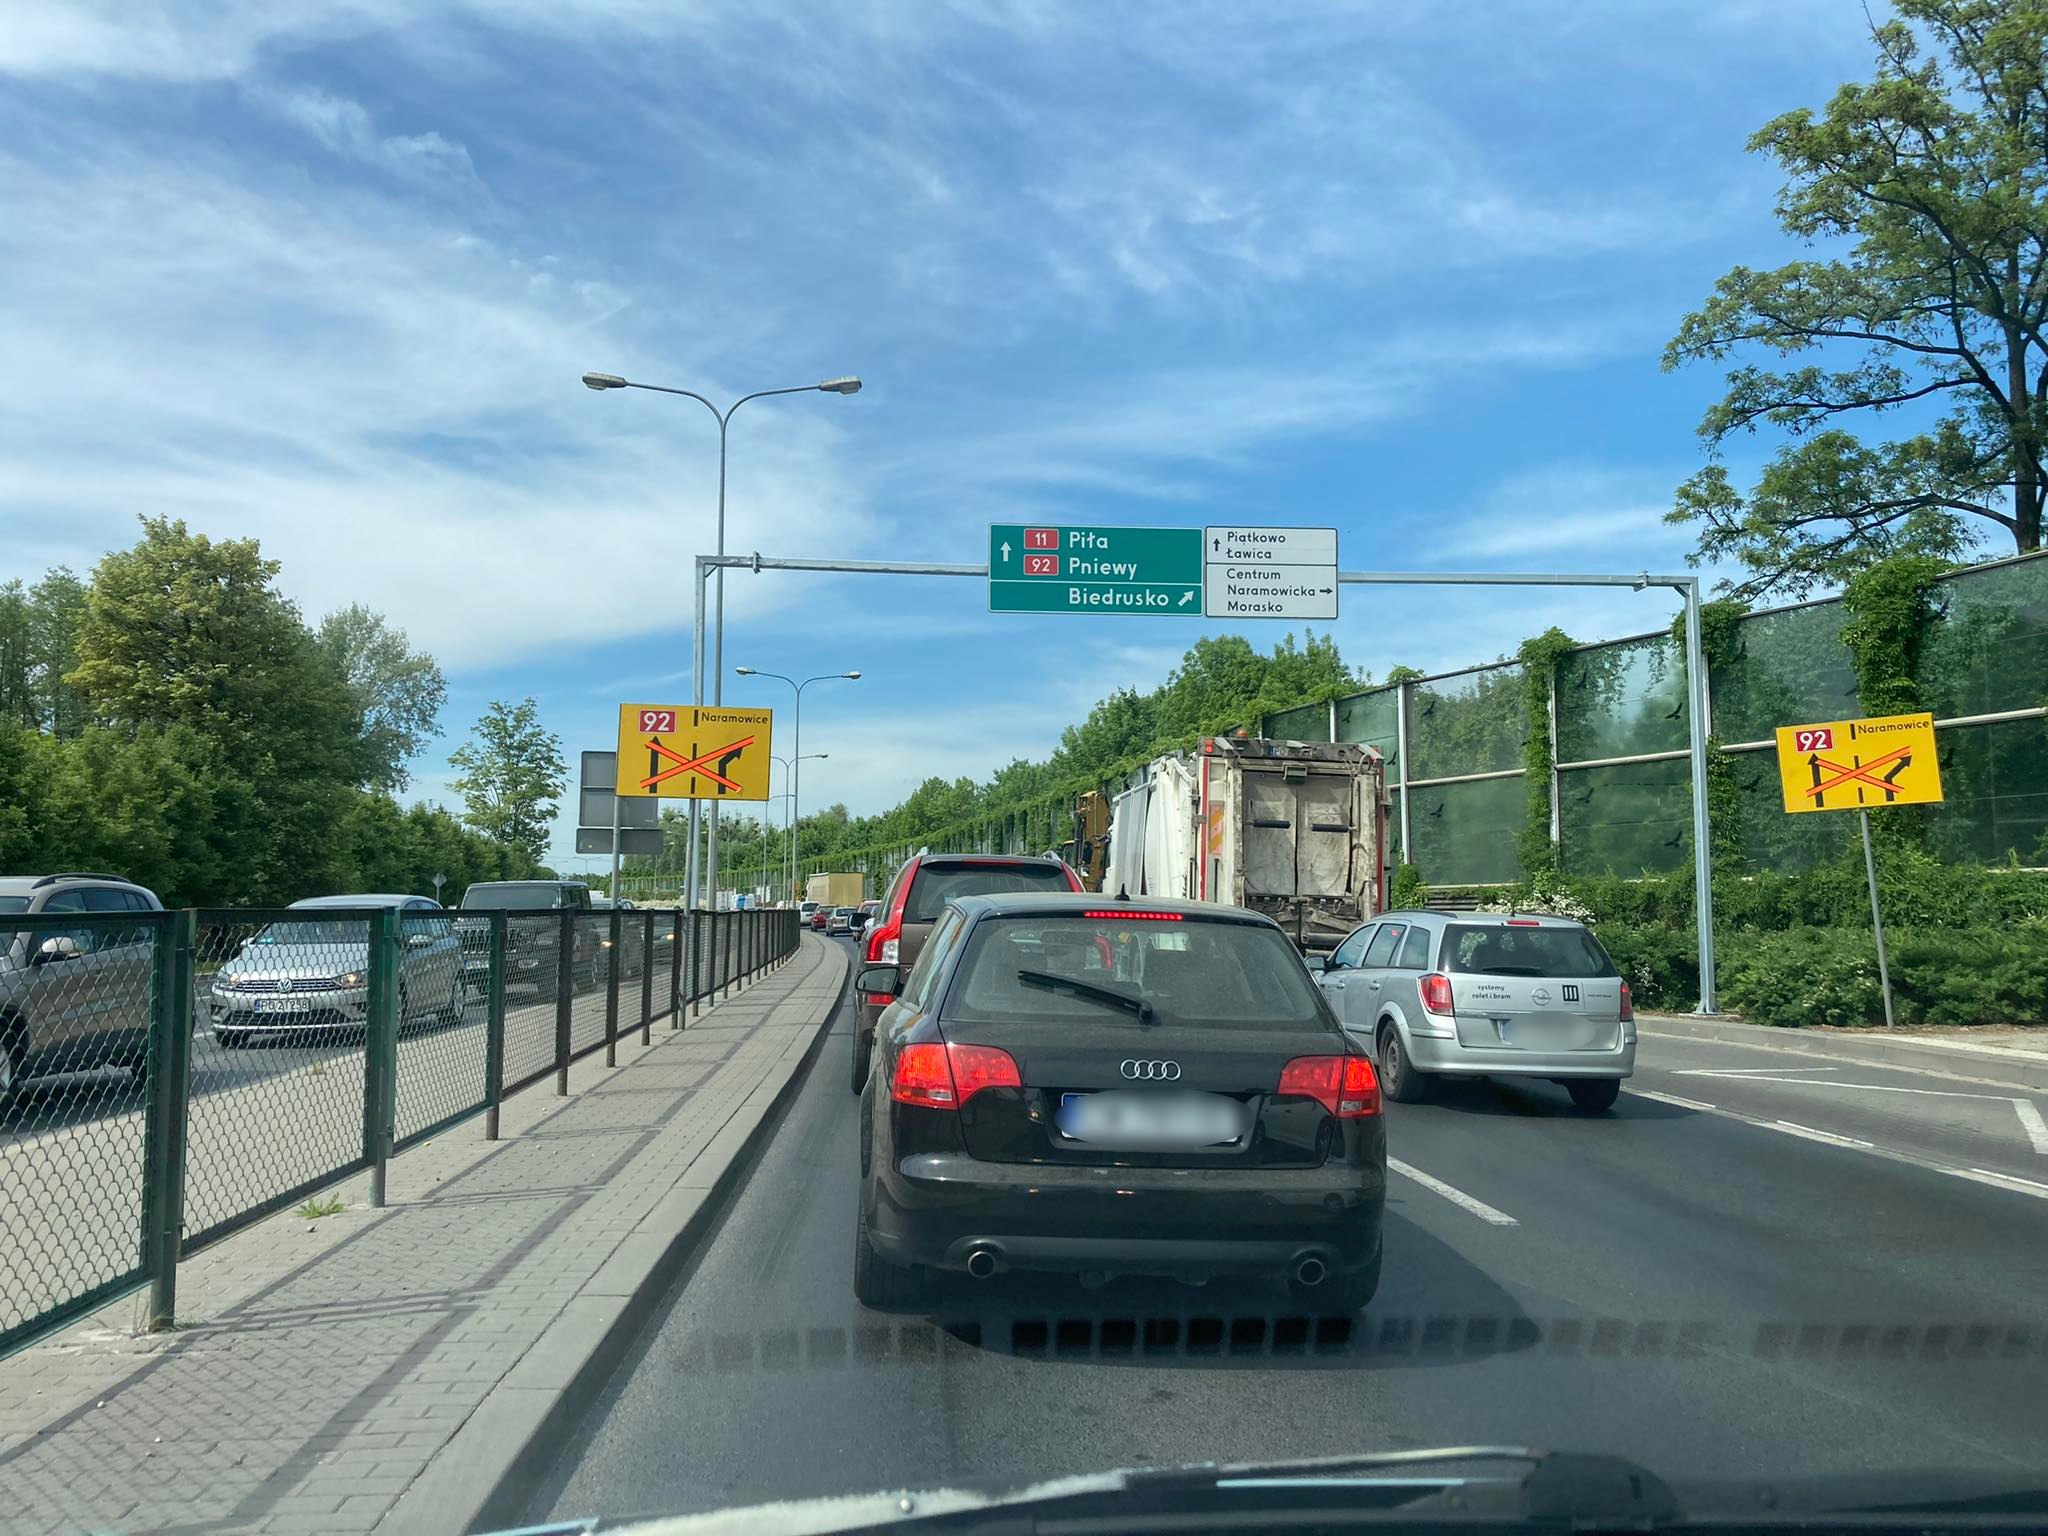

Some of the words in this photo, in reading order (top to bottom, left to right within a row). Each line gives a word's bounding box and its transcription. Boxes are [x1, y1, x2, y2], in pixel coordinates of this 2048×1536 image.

[1035, 533, 1047, 546] 11
[1069, 532, 1108, 549] Piła
[1227, 531, 1286, 545] Piątkowo
[1226, 547, 1272, 559] Ławica
[1032, 558, 1051, 572] 92
[1069, 558, 1138, 580] Pniewy
[1226, 568, 1281, 580] Centrum
[1068, 588, 1169, 607] Biedrusko
[1227, 584, 1316, 597] Naramowicka
[1227, 601, 1283, 613] Morasko
[643, 711, 671, 732] 92
[701, 711, 769, 724] Naramowice
[1857, 720, 1930, 735] Naramowice
[1799, 731, 1828, 751] 92
